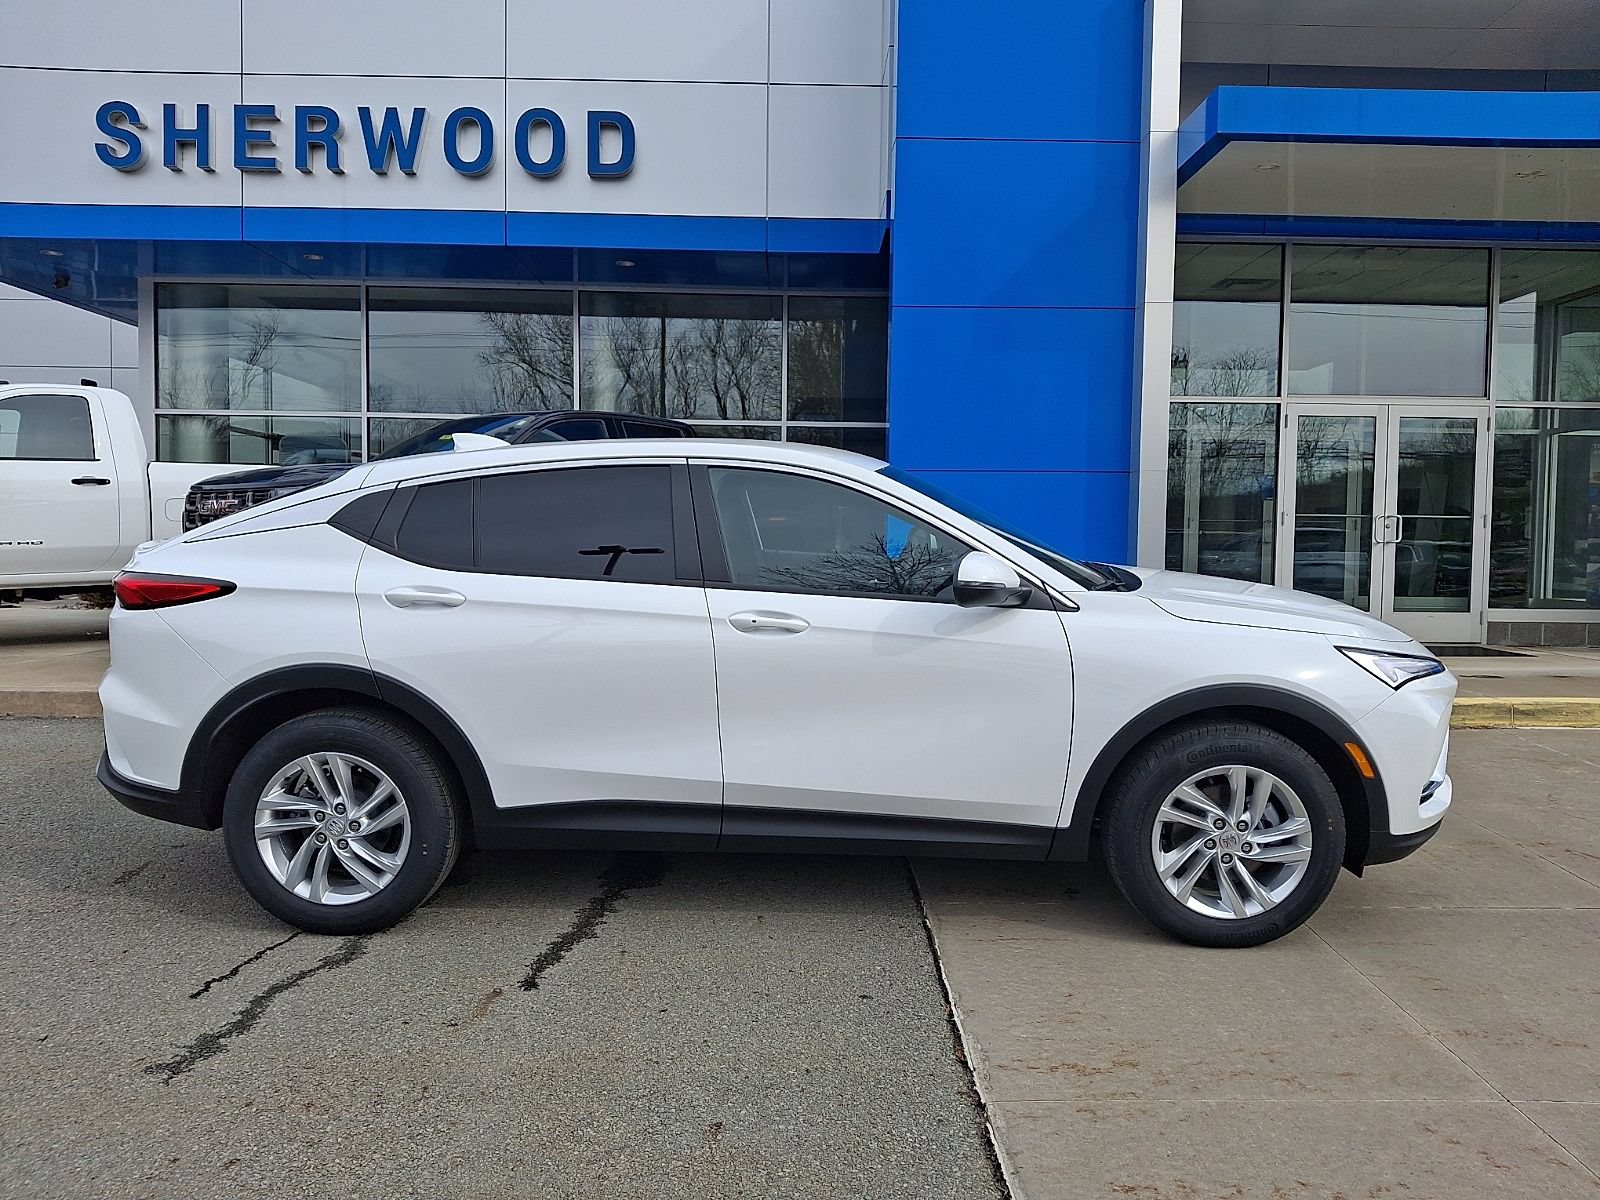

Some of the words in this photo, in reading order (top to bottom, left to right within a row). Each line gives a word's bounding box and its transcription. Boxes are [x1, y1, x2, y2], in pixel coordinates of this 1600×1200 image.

[94, 100, 636, 178] SHERWOOD
[197, 499, 239, 515] GMC
[1186, 742, 1252, 763] Continental
